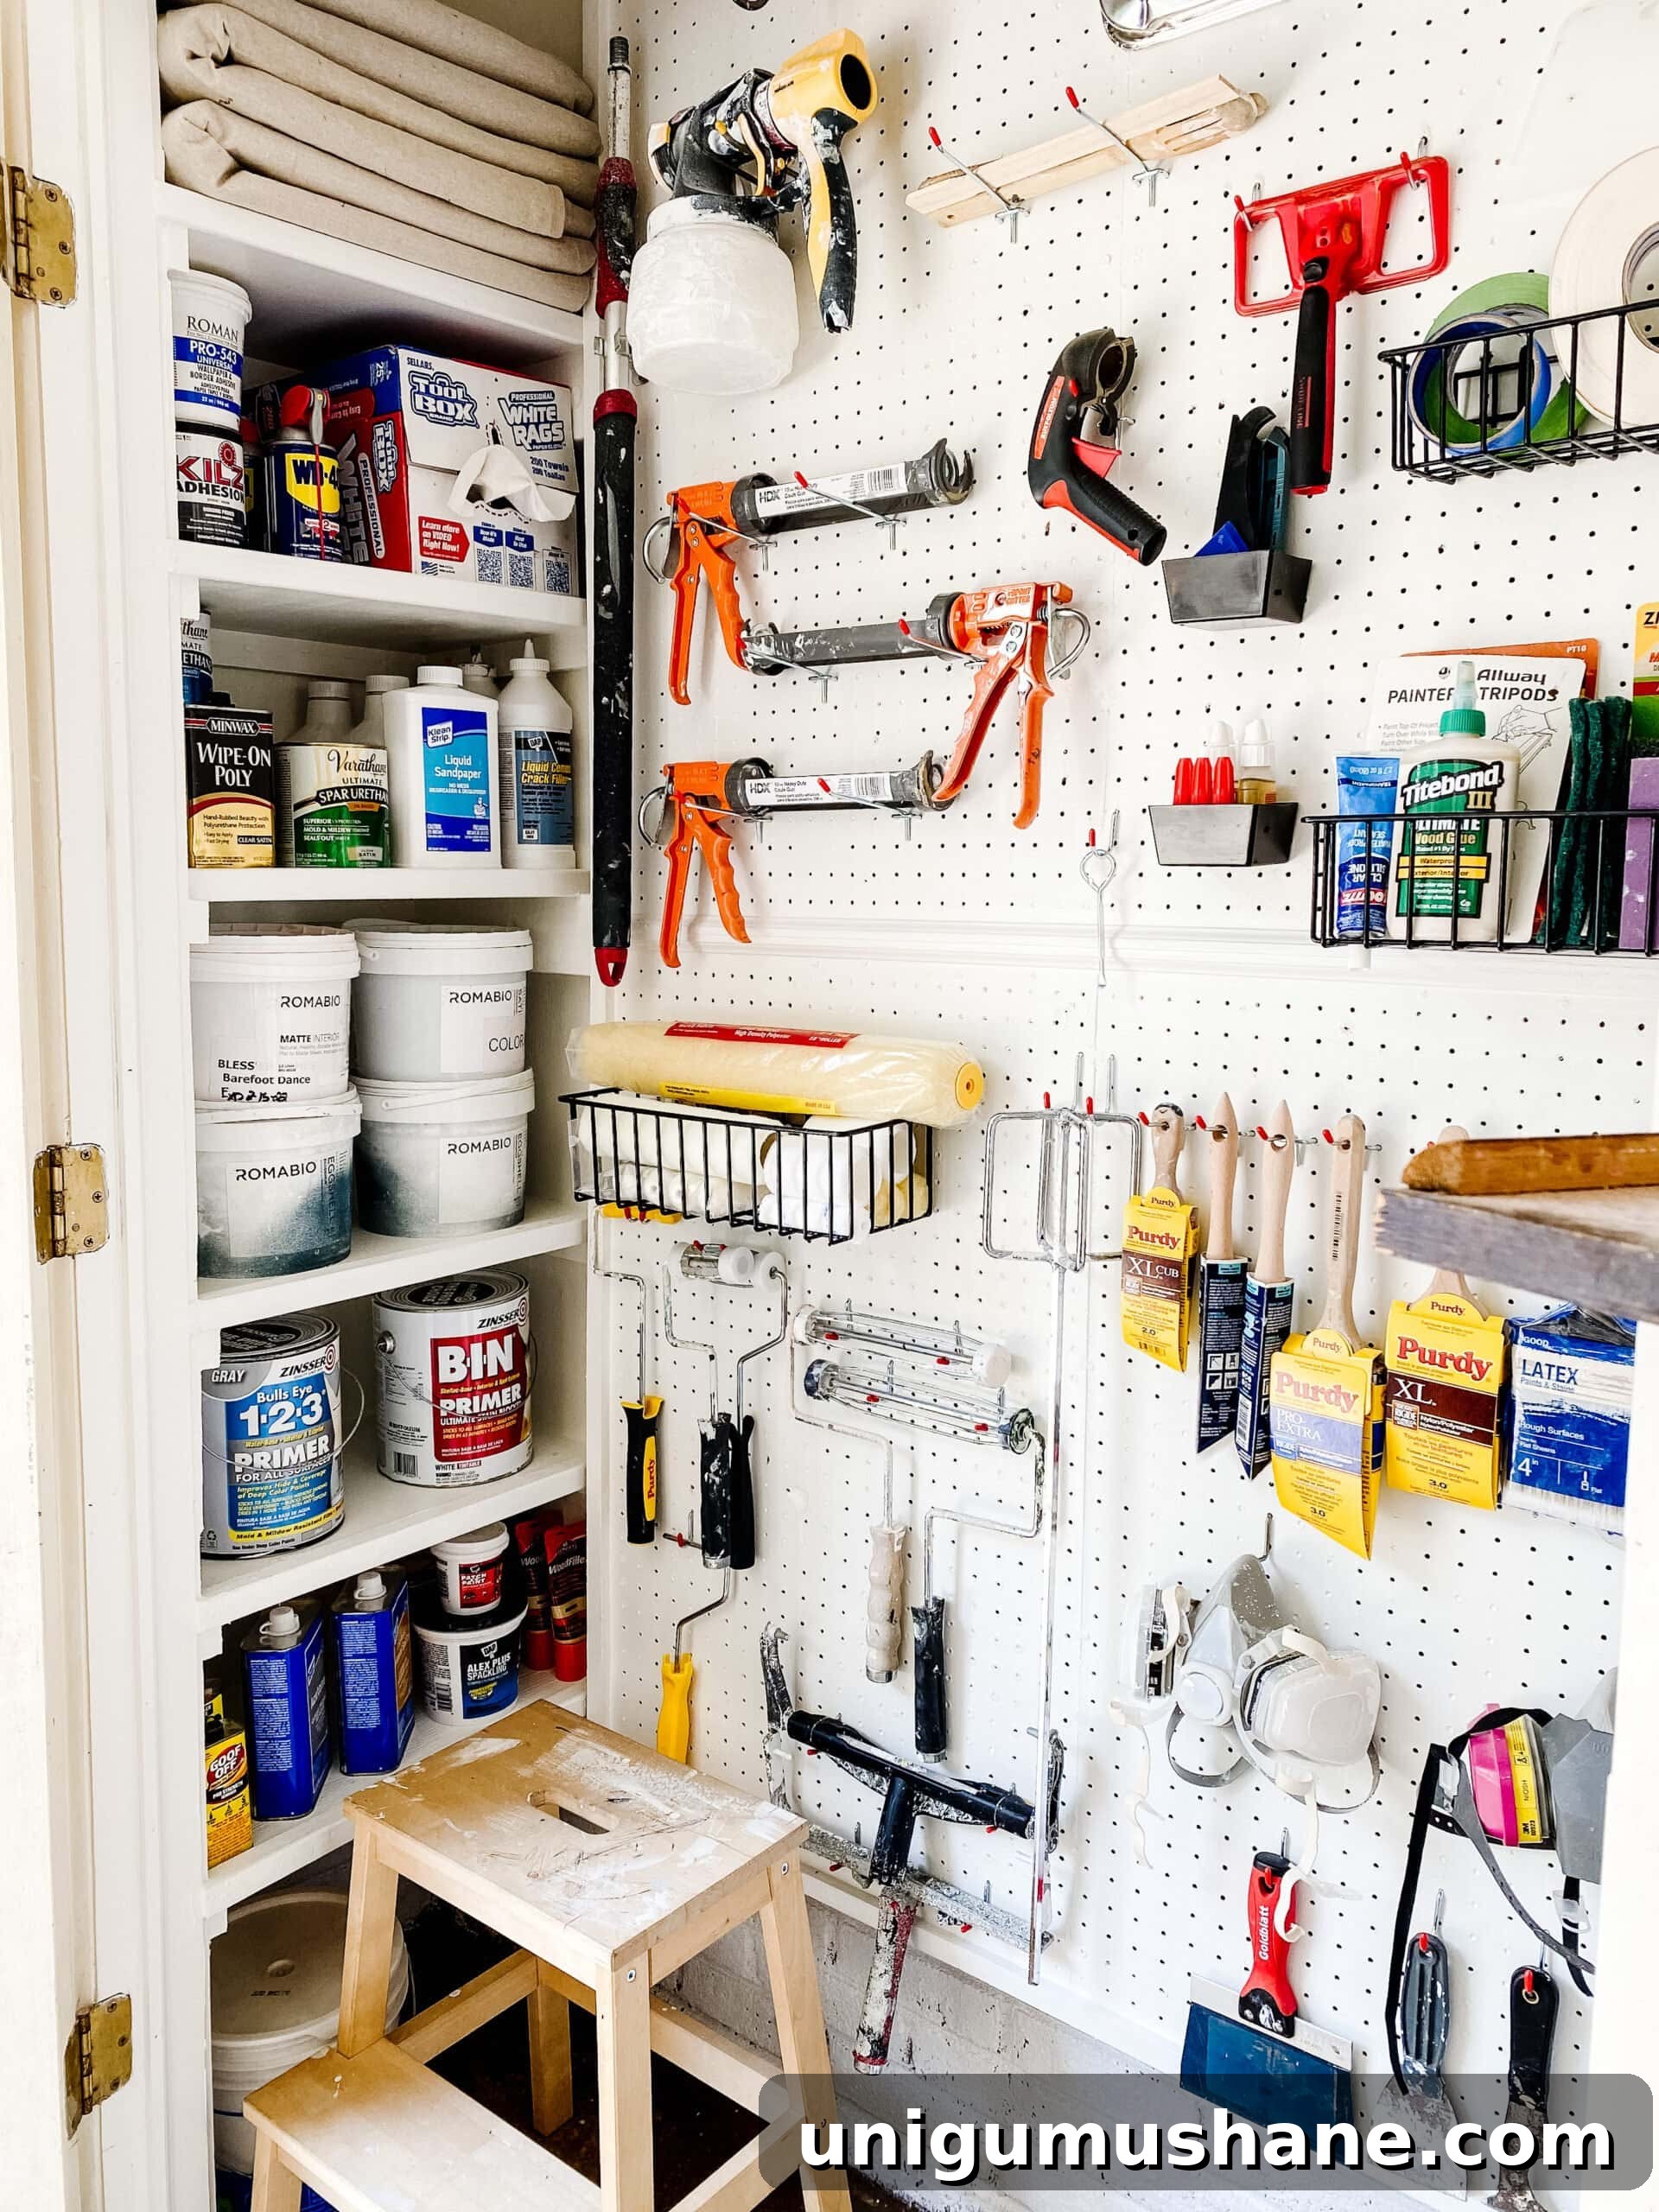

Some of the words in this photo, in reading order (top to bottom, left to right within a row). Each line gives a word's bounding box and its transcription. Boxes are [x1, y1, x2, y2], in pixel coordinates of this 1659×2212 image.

[187, 315, 238, 342] ROMAN
[189, 340, 237, 365] PRO-543
[197, 355, 233, 372] UNIVERSAL
[197, 365, 228, 378] WALLPAPER
[190, 371, 213, 382] BORDER
[215, 377, 236, 390] ADHESIVE
[412, 375, 469, 402] TOOL
[415, 394, 474, 422] BOX
[498, 397, 557, 425] WHITE
[513, 423, 564, 449] RAGS
[385, 424, 397, 479] TOOL
[375, 427, 390, 492] BOX
[544, 459, 569, 472] Towels
[759, 489, 780, 504] HDX
[359, 459, 384, 556] PROFESSIONAL
[422, 520, 442, 531] Learn
[442, 523, 460, 534] more
[432, 531, 452, 542] VIDEO
[423, 539, 442, 550] Right
[442, 542, 460, 552] Now!
[1477, 669, 1547, 685] Allway
[1479, 687, 1560, 702] TRIPODS
[211, 720, 255, 734] MINWAX
[428, 727, 451, 736] Klean
[197, 742, 271, 767] WIPE-ON
[445, 754, 472, 768] Liquid
[434, 766, 482, 782] Sandpaper
[521, 760, 550, 773] Liquid
[215, 766, 252, 786] POLY
[342, 778, 383, 786] ULTIMATE
[521, 772, 550, 785] Crack
[750, 783, 771, 794] HDX
[1403, 765, 1499, 806] Titebond
[318, 789, 350, 804] SPAR
[1467, 791, 1493, 810] III
[1446, 832, 1476, 844] Gue
[1352, 873, 1382, 883] CLAR
[280, 995, 340, 1008] ROMABIO
[449, 989, 512, 1003] ROMABIO
[280, 1035, 312, 1044] MATTE
[218, 1058, 256, 1071] BLESS
[222, 1073, 275, 1084] Barefoot
[277, 1076, 311, 1084] Dance
[447, 1137, 512, 1155] ROMABIO
[236, 1161, 317, 1181] ROMABIO
[1151, 1197, 1176, 1208] Purdy
[1128, 1225, 1180, 1249] Purdy
[1128, 1255, 1159, 1279] XL
[1155, 1264, 1179, 1278] CUB
[1430, 1301, 1465, 1316] Purdy
[477, 1308, 518, 1329] ZINSSER
[1142, 1326, 1156, 1336] 2.0
[1313, 1338, 1342, 1353] Purdy
[1523, 1336, 1549, 1349] GOOD
[279, 1357, 326, 1377] ZINSSER
[1397, 1337, 1494, 1382] Purdy
[211, 1370, 245, 1383] GRAY
[1522, 1359, 1580, 1386] LATEX
[1521, 1377, 1542, 1388] Paints
[257, 1389, 289, 1403] Bulls
[292, 1384, 313, 1400] Eye
[1275, 1371, 1359, 1414] Purdy
[1394, 1377, 1432, 1405] XL
[439, 1382, 522, 1417] PRIMER
[441, 1416, 475, 1426] ULTIMATE
[1277, 1421, 1321, 1442] EXTRA
[1520, 1421, 1547, 1433] Rough
[1548, 1426, 1585, 1441] Surfaces
[234, 1434, 330, 1473] PRIMER
[1518, 1457, 1533, 1478] 4
[1532, 1458, 1539, 1466] in
[236, 1472, 260, 1484] FOR
[264, 1471, 284, 1481] ALL
[1428, 1478, 1448, 1490] 3.0
[238, 1485, 273, 1494] Improves
[269, 1487, 288, 1496] Color
[290, 1482, 310, 1492] Paints
[1310, 1506, 1326, 1517] 3.0
[266, 1528, 292, 1536] Mildew
[294, 1518, 322, 1531] Resistant
[461, 1573, 486, 1581] PATCH
[483, 1643, 497, 1654] DAP
[467, 1661, 490, 1672] ALEX
[492, 1651, 512, 1666] PLUS
[467, 1664, 507, 1681] SPACKLING
[210, 1744, 243, 1769] GOOF
[215, 1758, 238, 1778] OFF
[1522, 1822, 1530, 1834] 3M
[1258, 1904, 1269, 1961] Goldblatt
